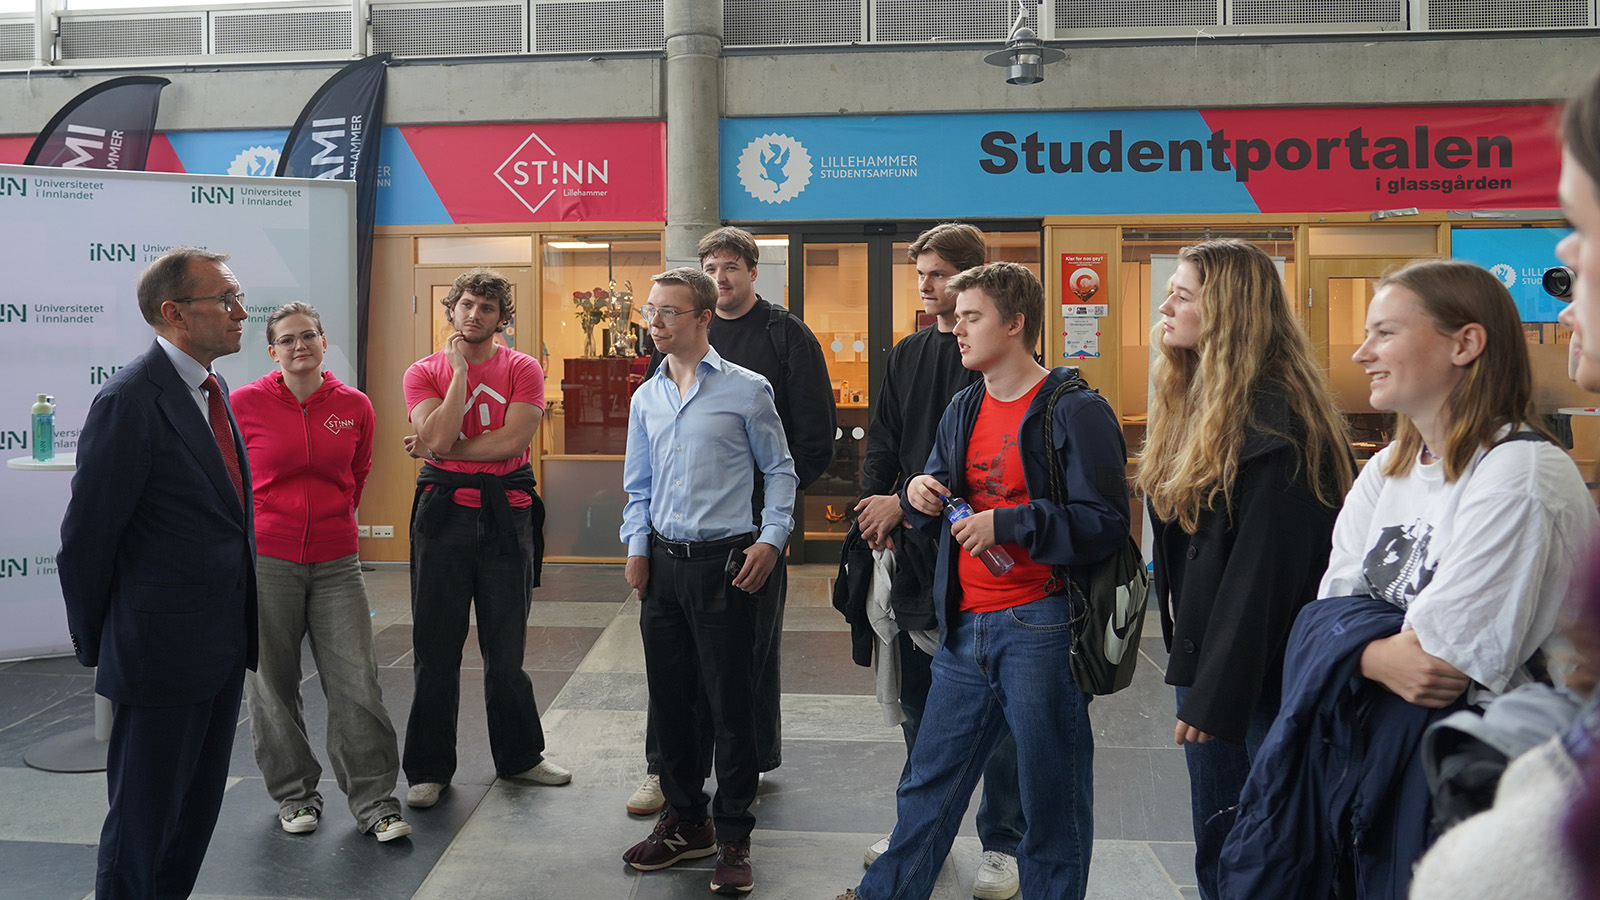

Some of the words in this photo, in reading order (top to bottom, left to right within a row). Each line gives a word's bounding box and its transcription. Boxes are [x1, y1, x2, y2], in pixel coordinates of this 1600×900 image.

[979, 126, 1513, 183] Studentportalen
[821, 155, 918, 168] LILLEHAMMER
[820, 168, 918, 179] STUDENTSAMFUNN
[34, 179, 104, 190] Universitetet
[1375, 177, 1381, 191] i
[1387, 175, 1512, 194] glassgården
[36, 189, 39, 197] i
[42, 190, 94, 200] Innlandet
[240, 187, 301, 198] Universitetet
[563, 189, 608, 197] Lillehammer
[242, 197, 245, 205] i
[247, 198, 292, 207] Innlandet
[34, 304, 104, 313] Universitetet
[36, 314, 39, 323] i
[42, 314, 94, 323] Innlandet
